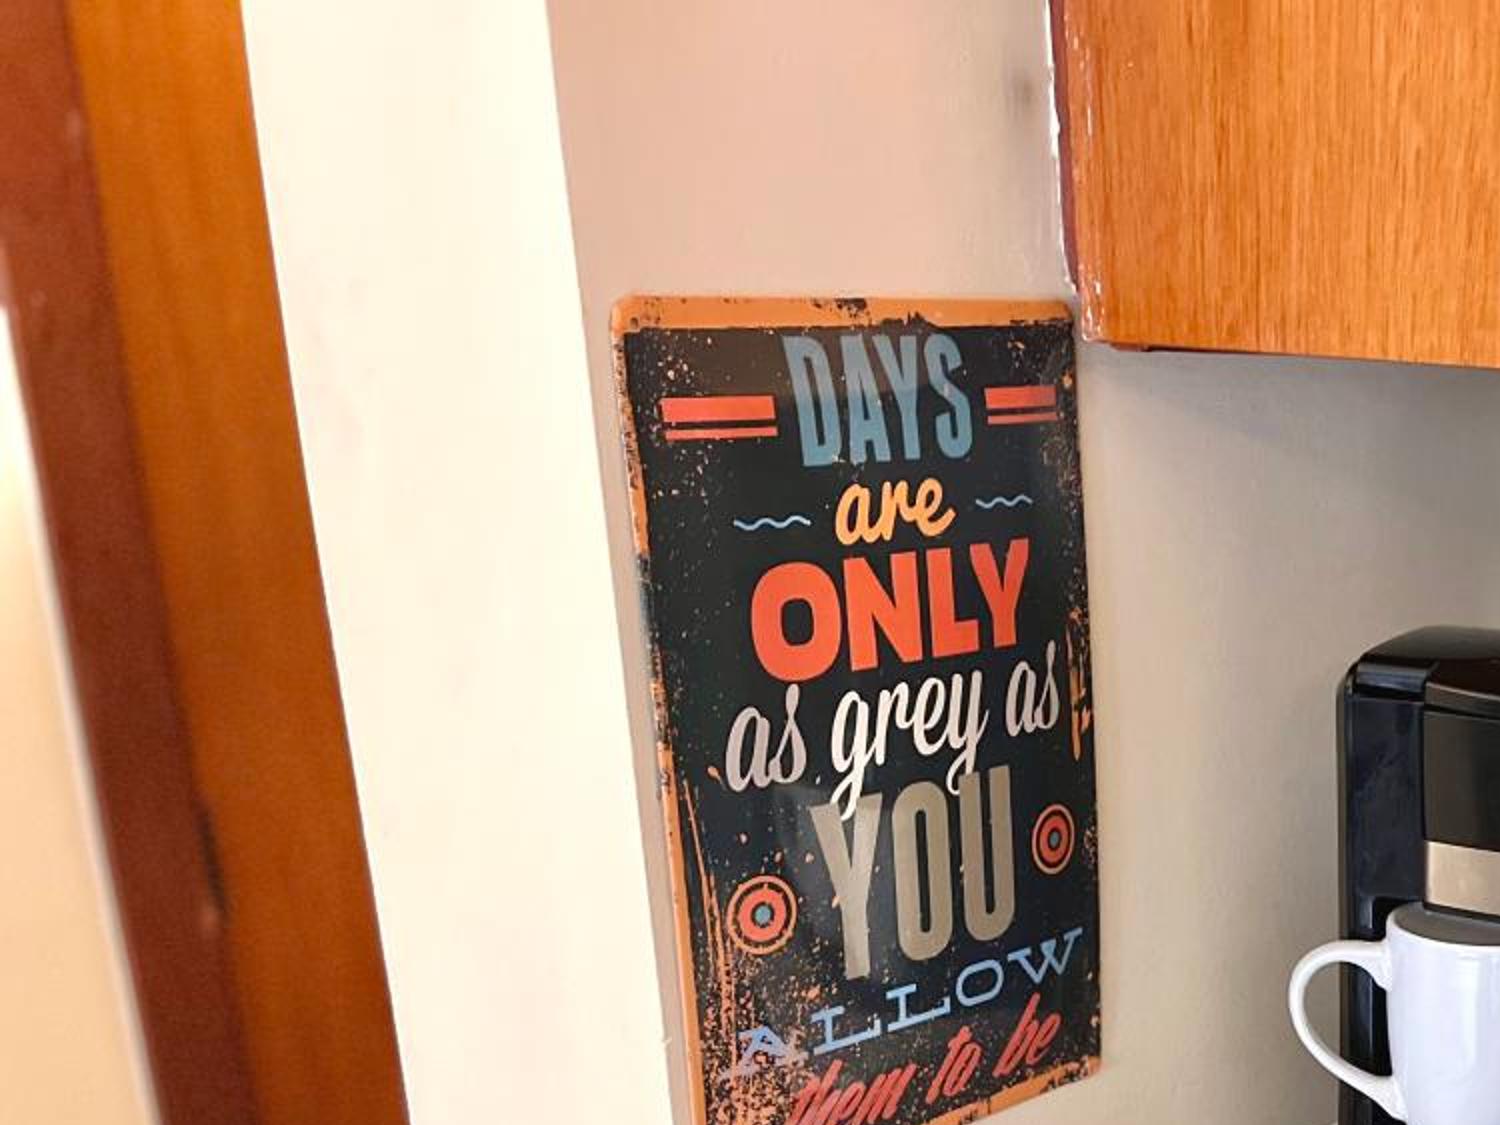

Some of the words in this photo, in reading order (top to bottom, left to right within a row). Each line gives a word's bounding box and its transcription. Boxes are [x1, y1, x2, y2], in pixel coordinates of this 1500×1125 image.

[782, 333, 973, 468] DAYS
[835, 477, 956, 545] are
[750, 537, 1030, 684] ONLY
[724, 684, 807, 792] as
[829, 669, 989, 821] grey
[1005, 640, 1060, 737] as
[809, 764, 1016, 980] YOU
[718, 926, 1084, 1080] ALLOW
[926, 1025, 983, 1104] to
[993, 991, 1063, 1078] be
